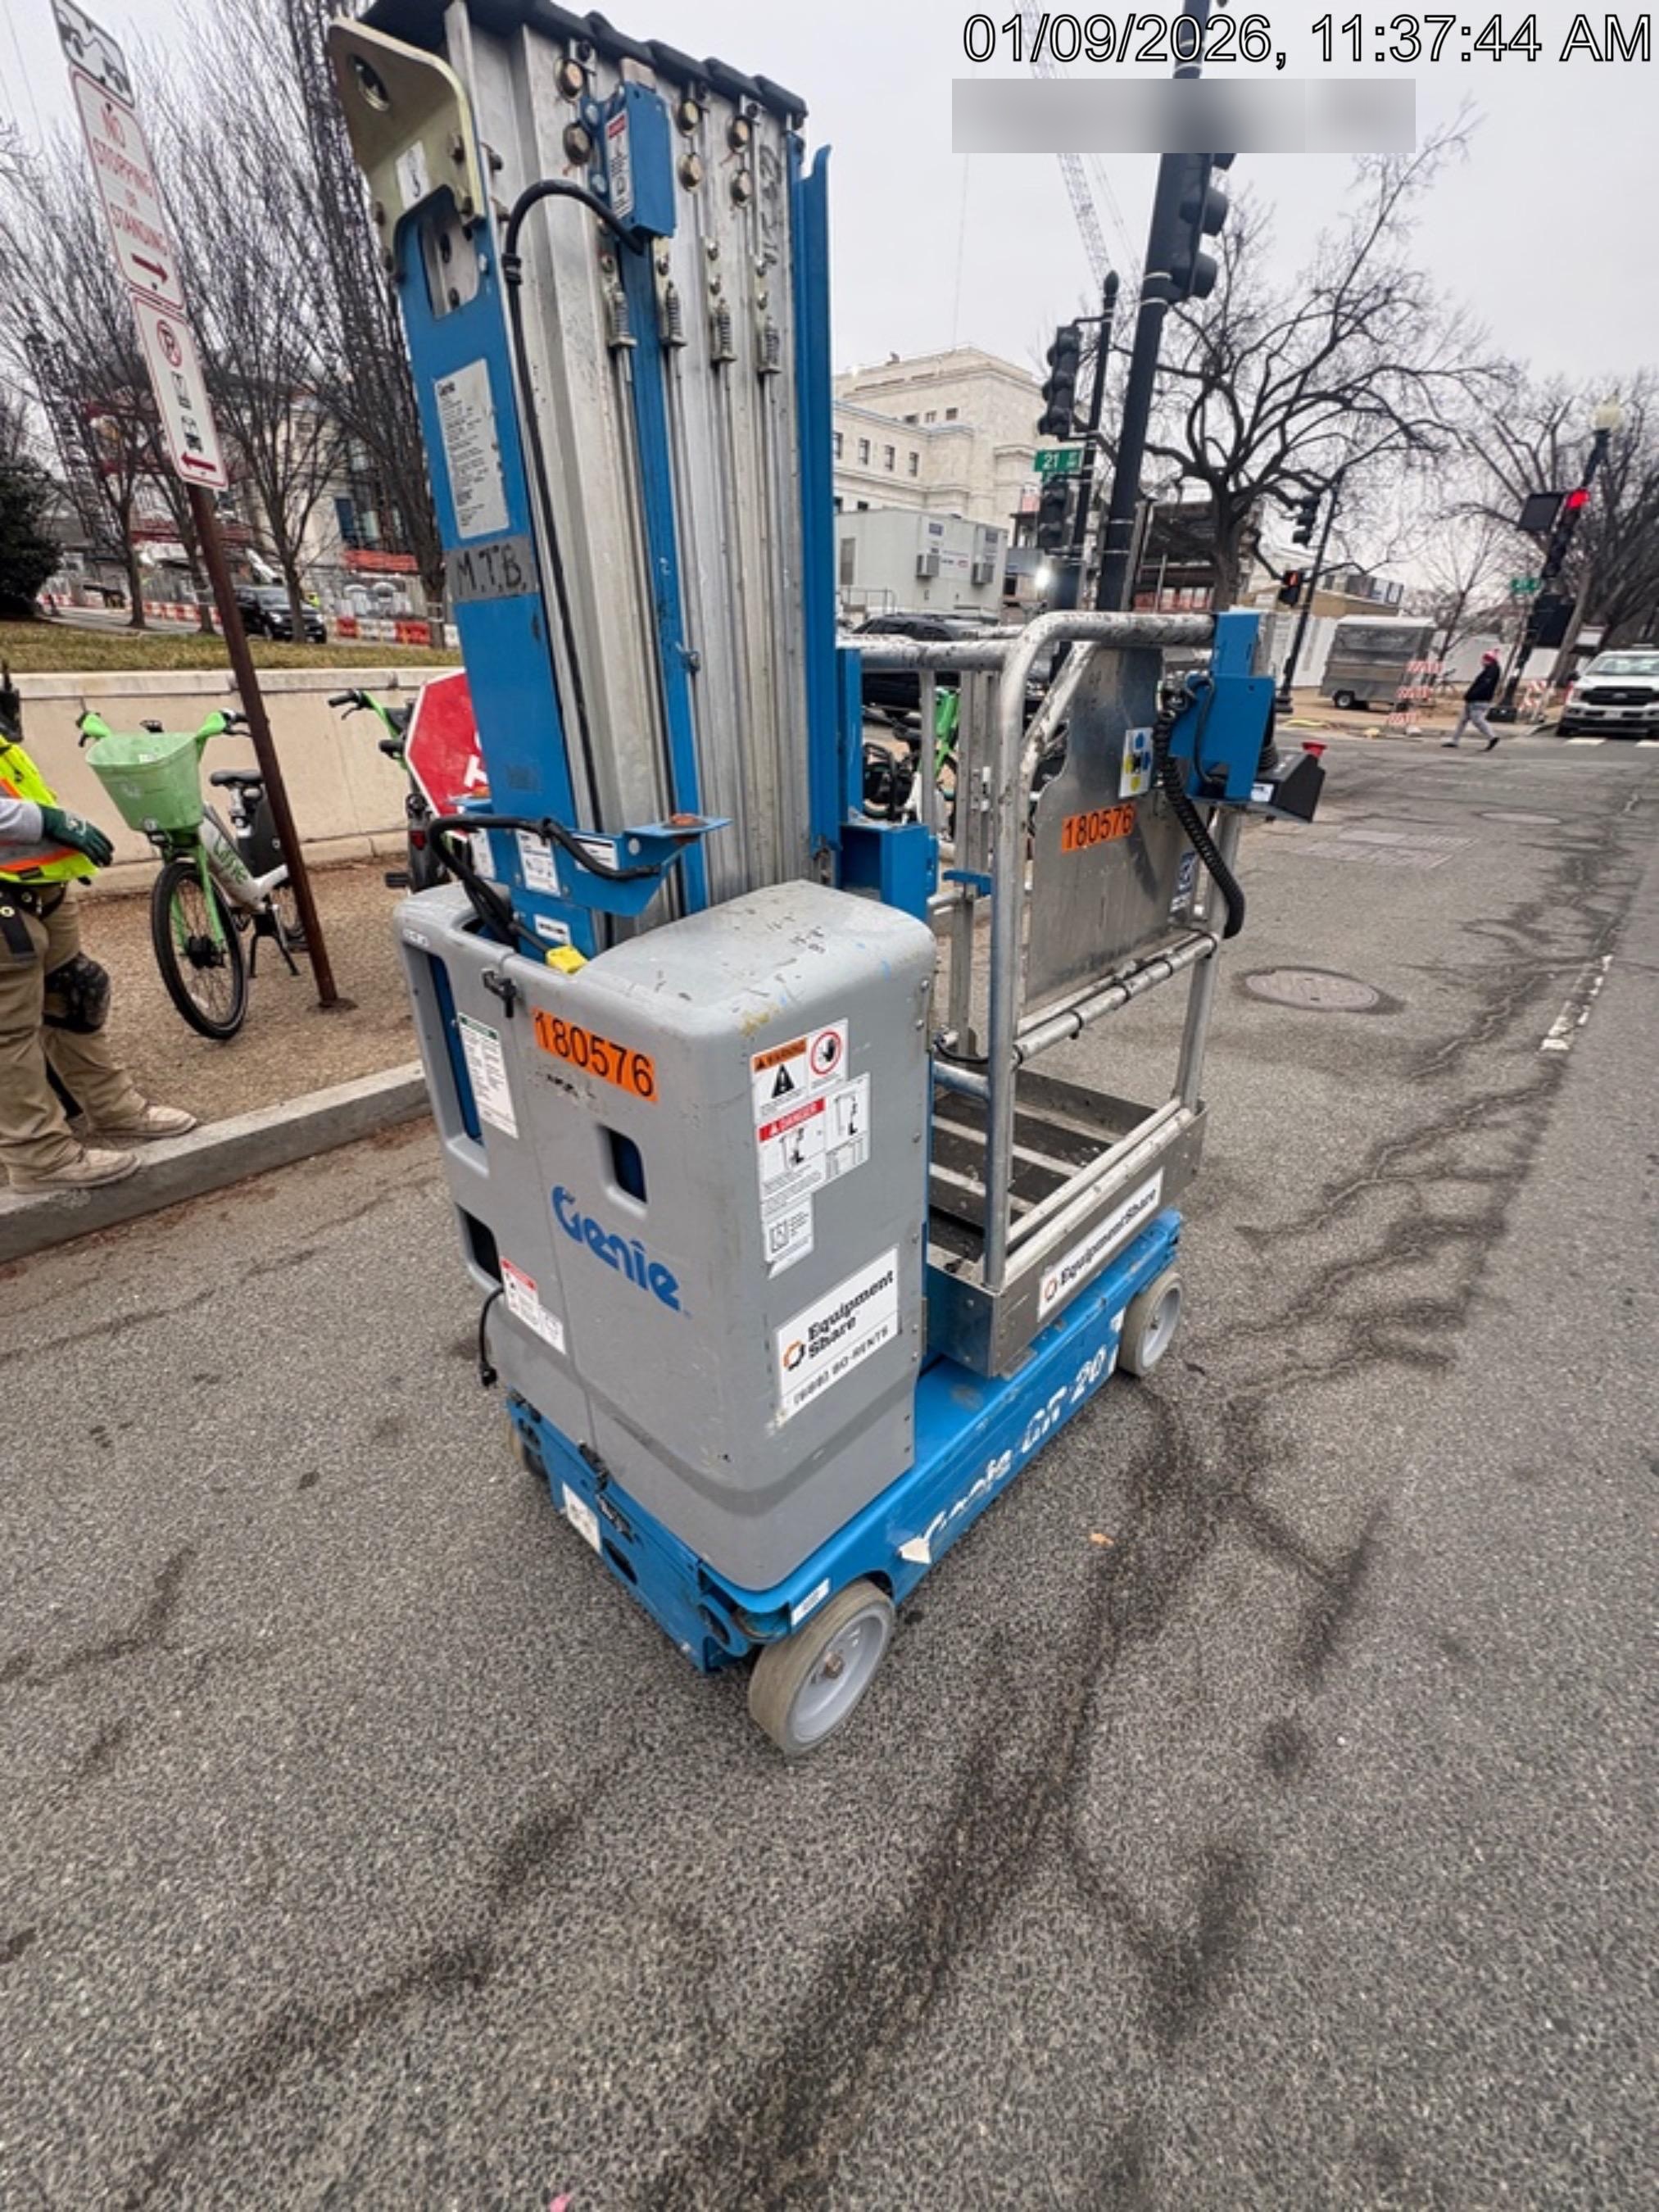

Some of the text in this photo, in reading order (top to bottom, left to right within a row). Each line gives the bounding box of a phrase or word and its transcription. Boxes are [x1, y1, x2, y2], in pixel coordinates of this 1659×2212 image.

[1042, 451, 1060, 469] 21
[1066, 804, 1133, 850] 180576
[535, 1012, 655, 1098] 180576
[777, 1101, 816, 1133] DANGER
[552, 1185, 682, 1312] Genie
[808, 1270, 894, 1341] Equipment
[808, 1316, 857, 1359] Share
